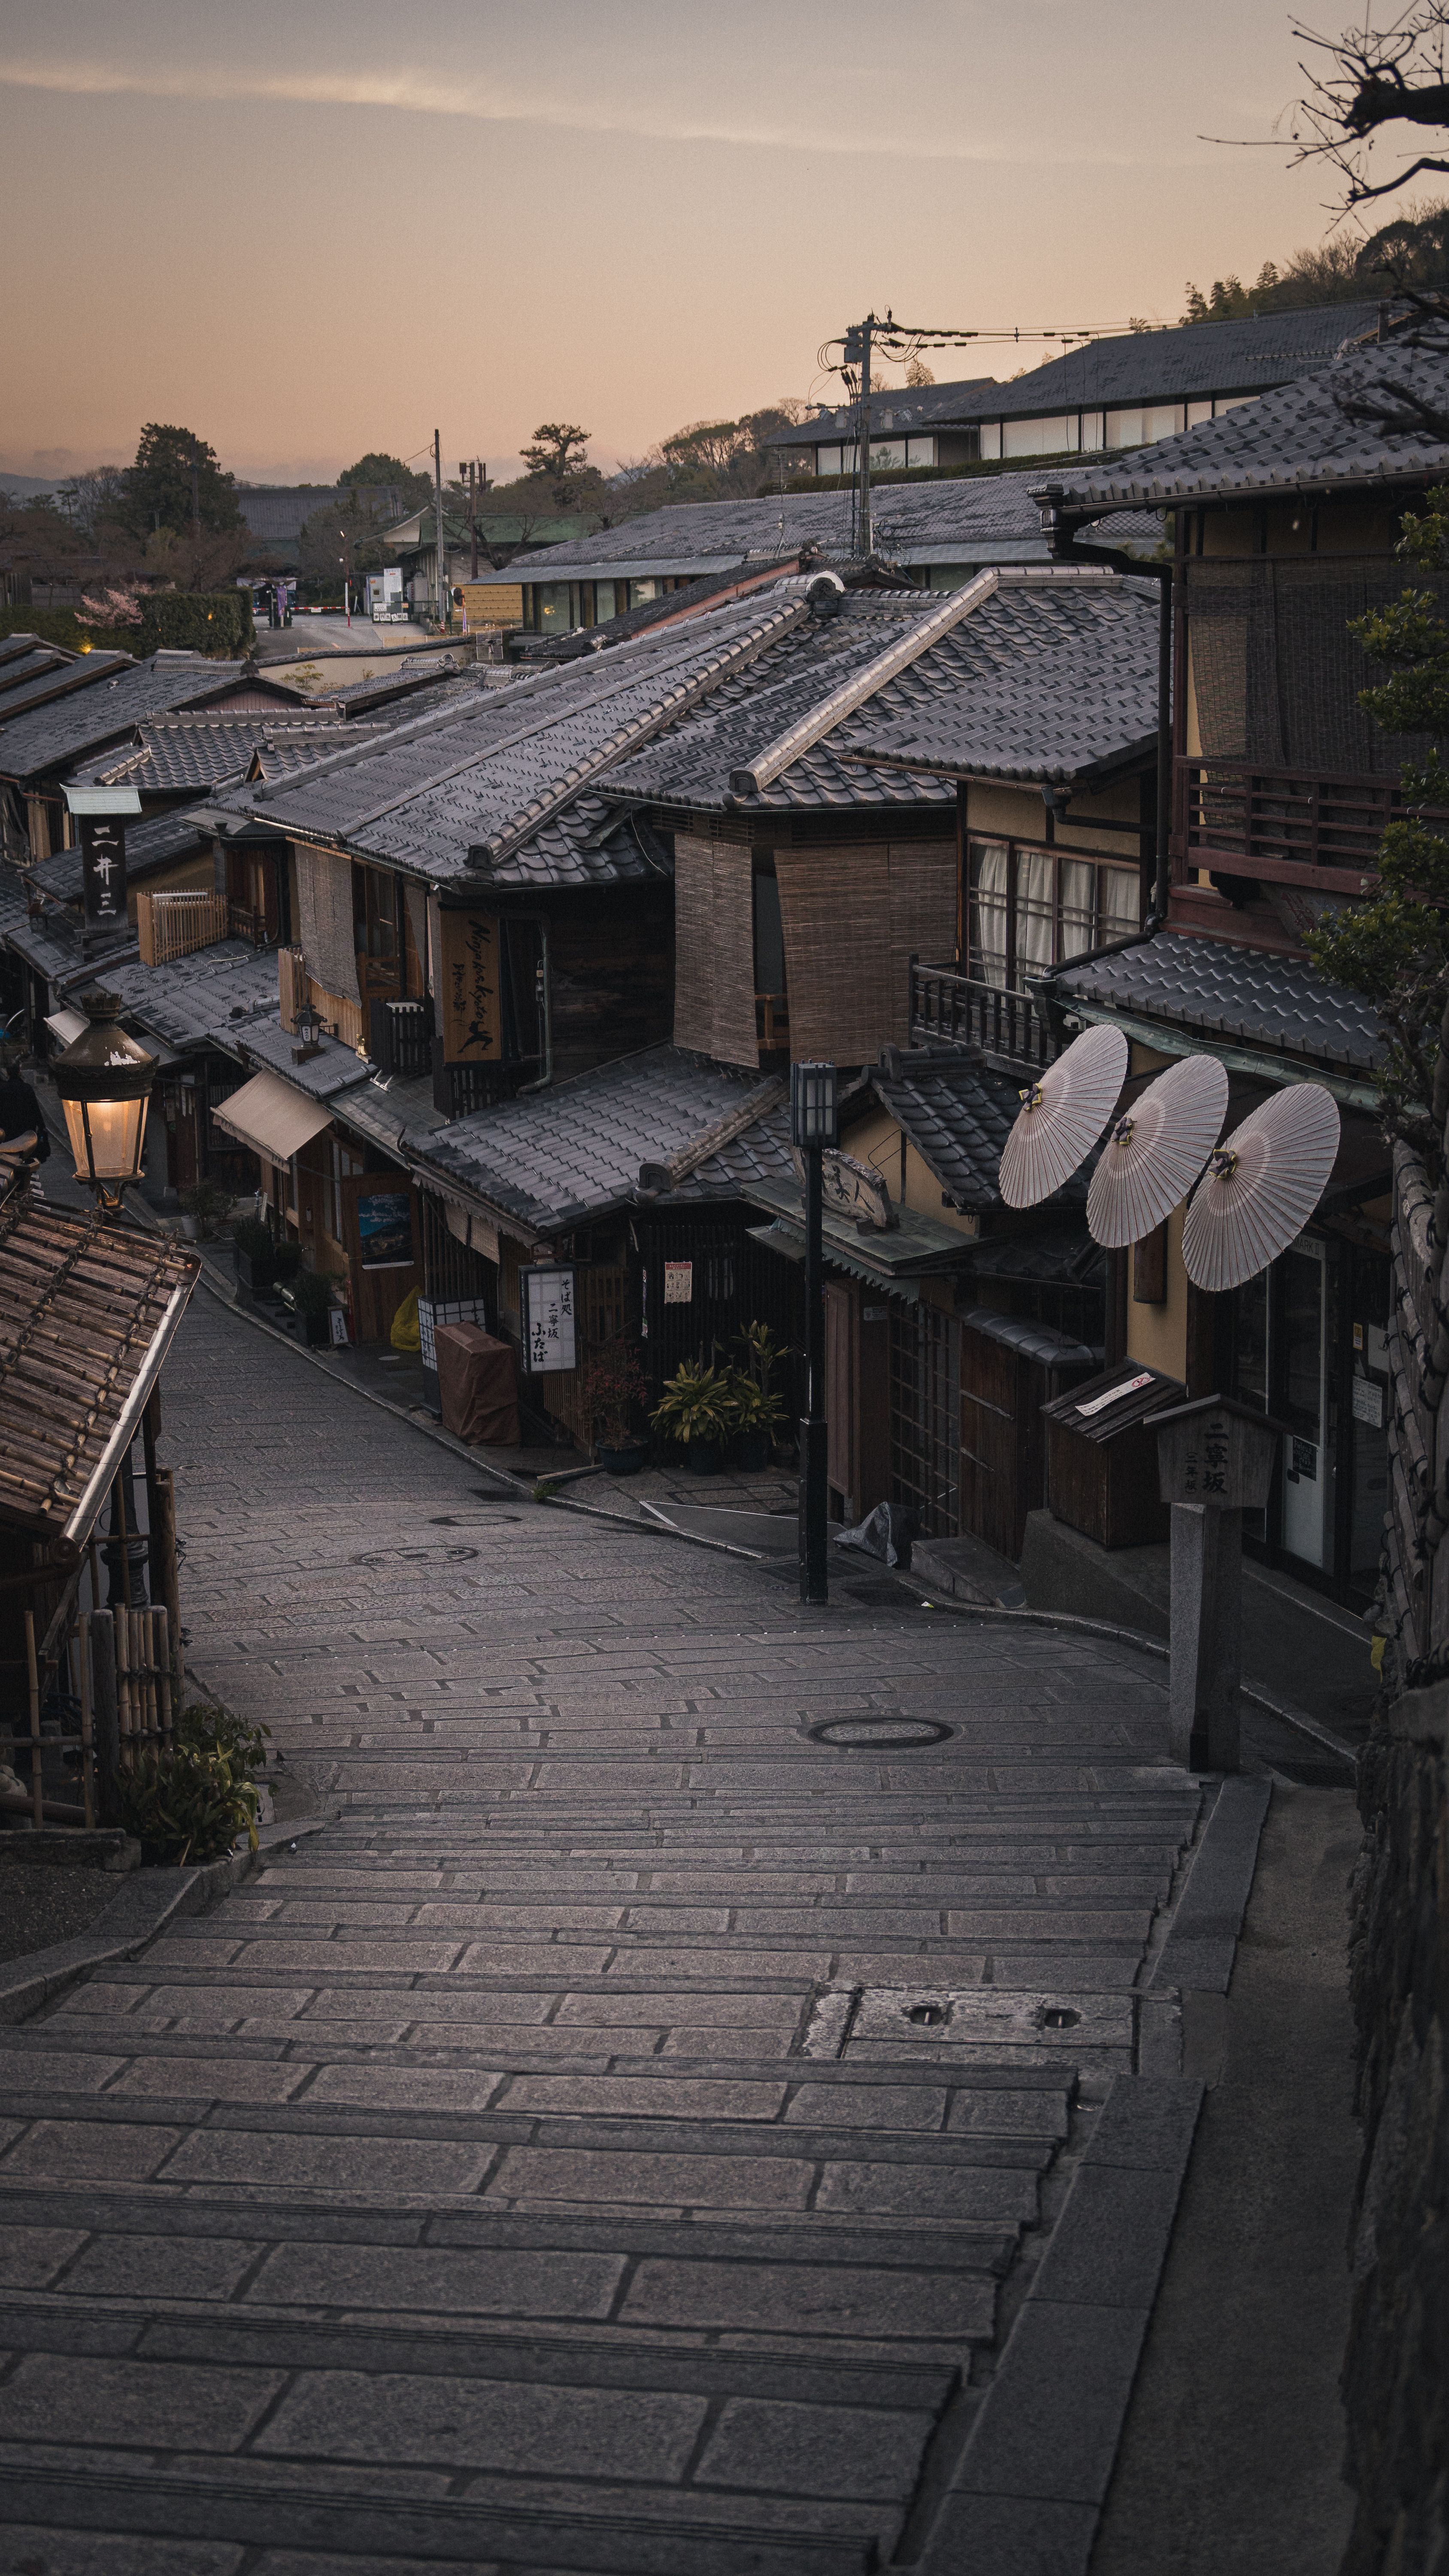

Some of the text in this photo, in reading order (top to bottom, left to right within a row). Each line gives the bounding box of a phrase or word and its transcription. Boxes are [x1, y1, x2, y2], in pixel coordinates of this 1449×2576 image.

[465, 920, 491, 960] Ninja
[468, 985, 494, 1019] Kyoto
[561, 1279, 572, 1315] そば処
[548, 1303, 559, 1339] 二寧坂
[532, 1322, 548, 1362] ふたば
[1202, 1423, 1229, 1494] 二寧坂
